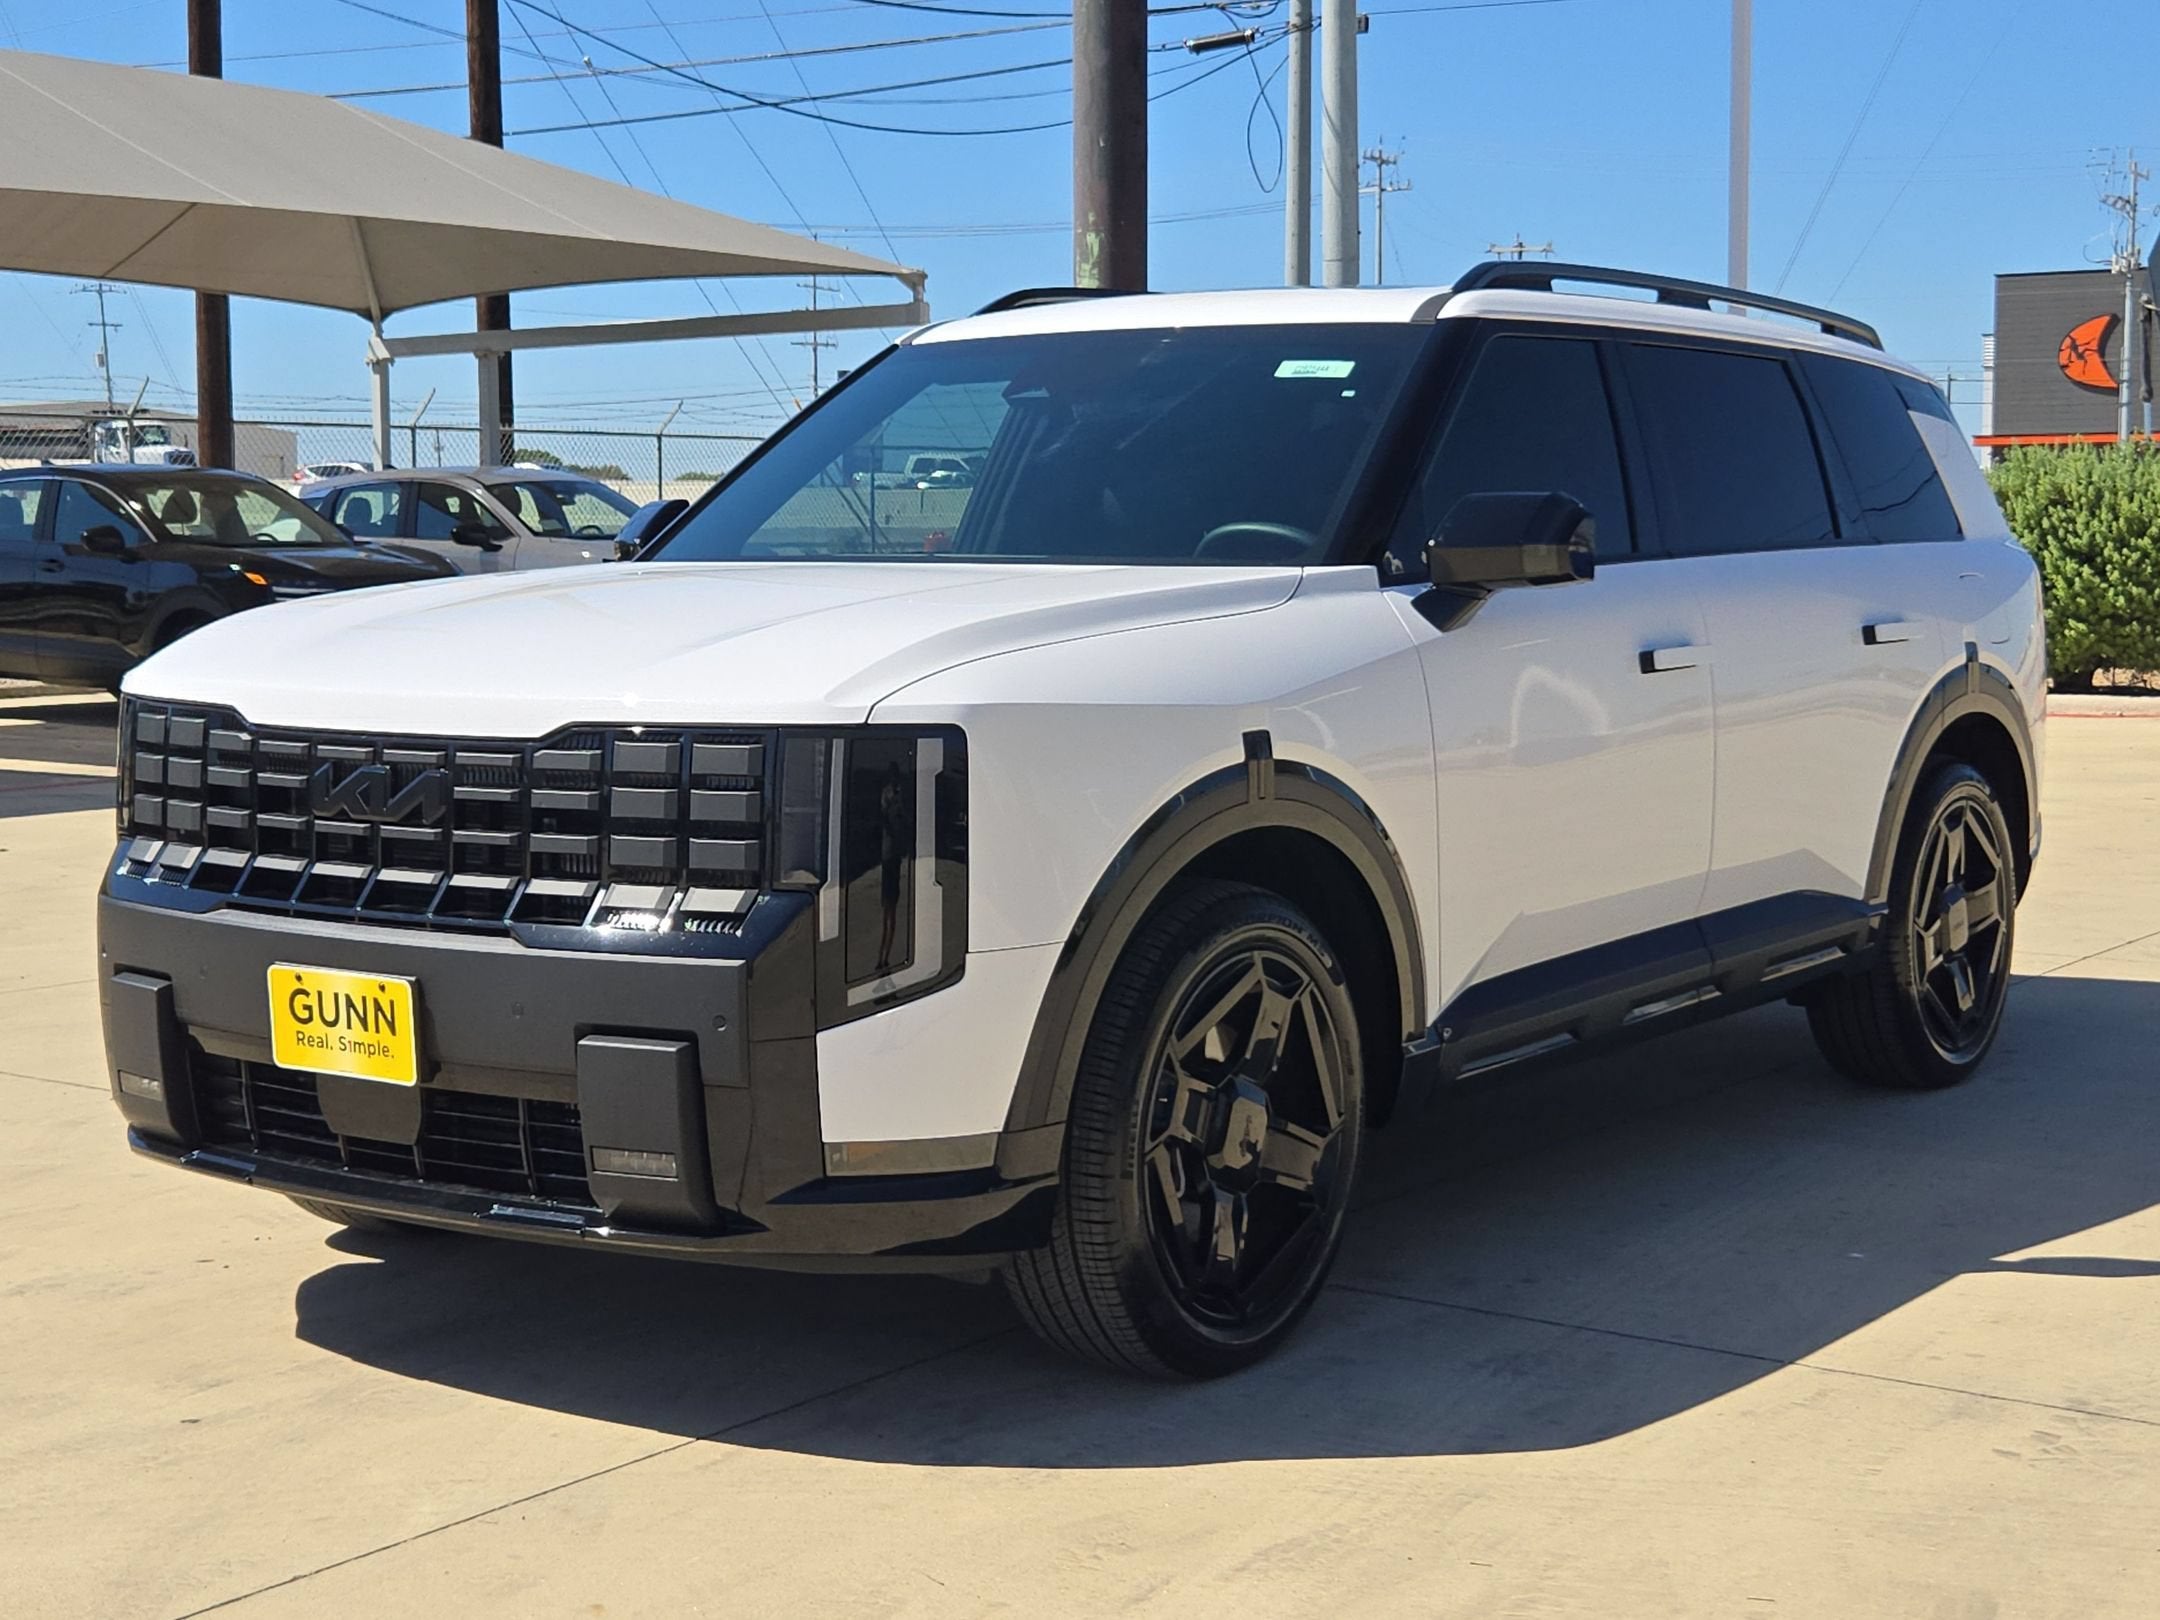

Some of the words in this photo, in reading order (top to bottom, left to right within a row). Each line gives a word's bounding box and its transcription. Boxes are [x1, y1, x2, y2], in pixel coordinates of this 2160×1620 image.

[310, 761, 449, 825] KIA
[288, 988, 397, 1036] GUNN
[296, 1030, 333, 1050] Real.
